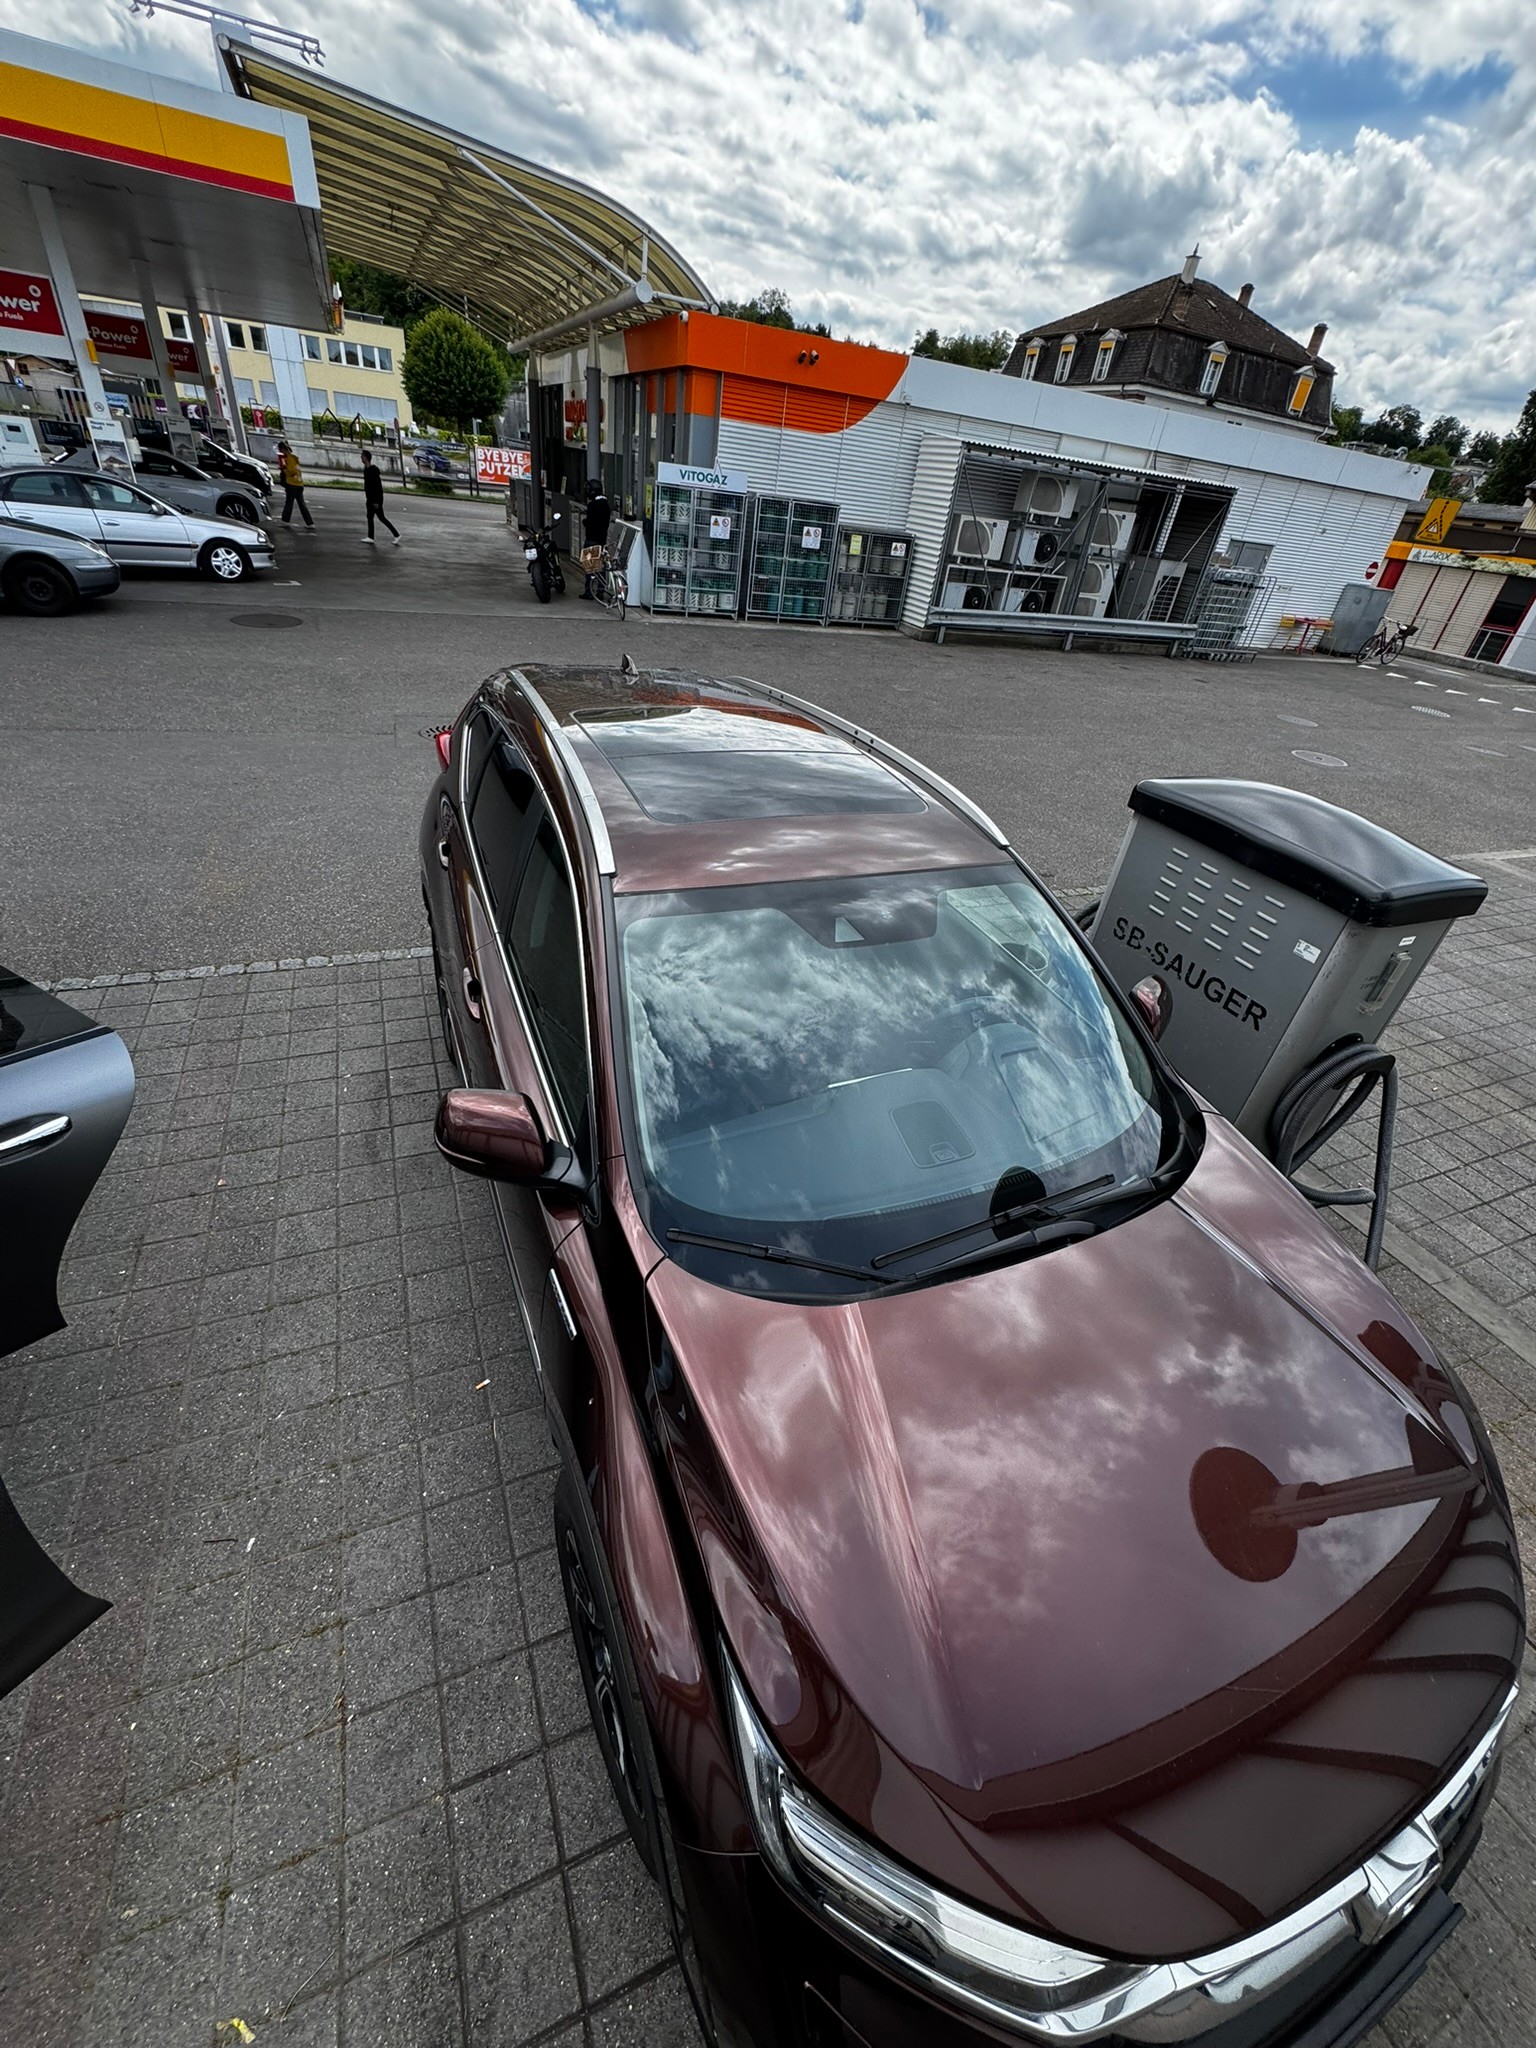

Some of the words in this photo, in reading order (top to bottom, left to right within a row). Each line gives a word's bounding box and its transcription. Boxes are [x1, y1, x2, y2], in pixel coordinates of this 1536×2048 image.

[477, 448, 500, 462] BYE
[502, 451, 524, 465] BYE
[1113, 917, 1268, 1032] SB-SAUGER
